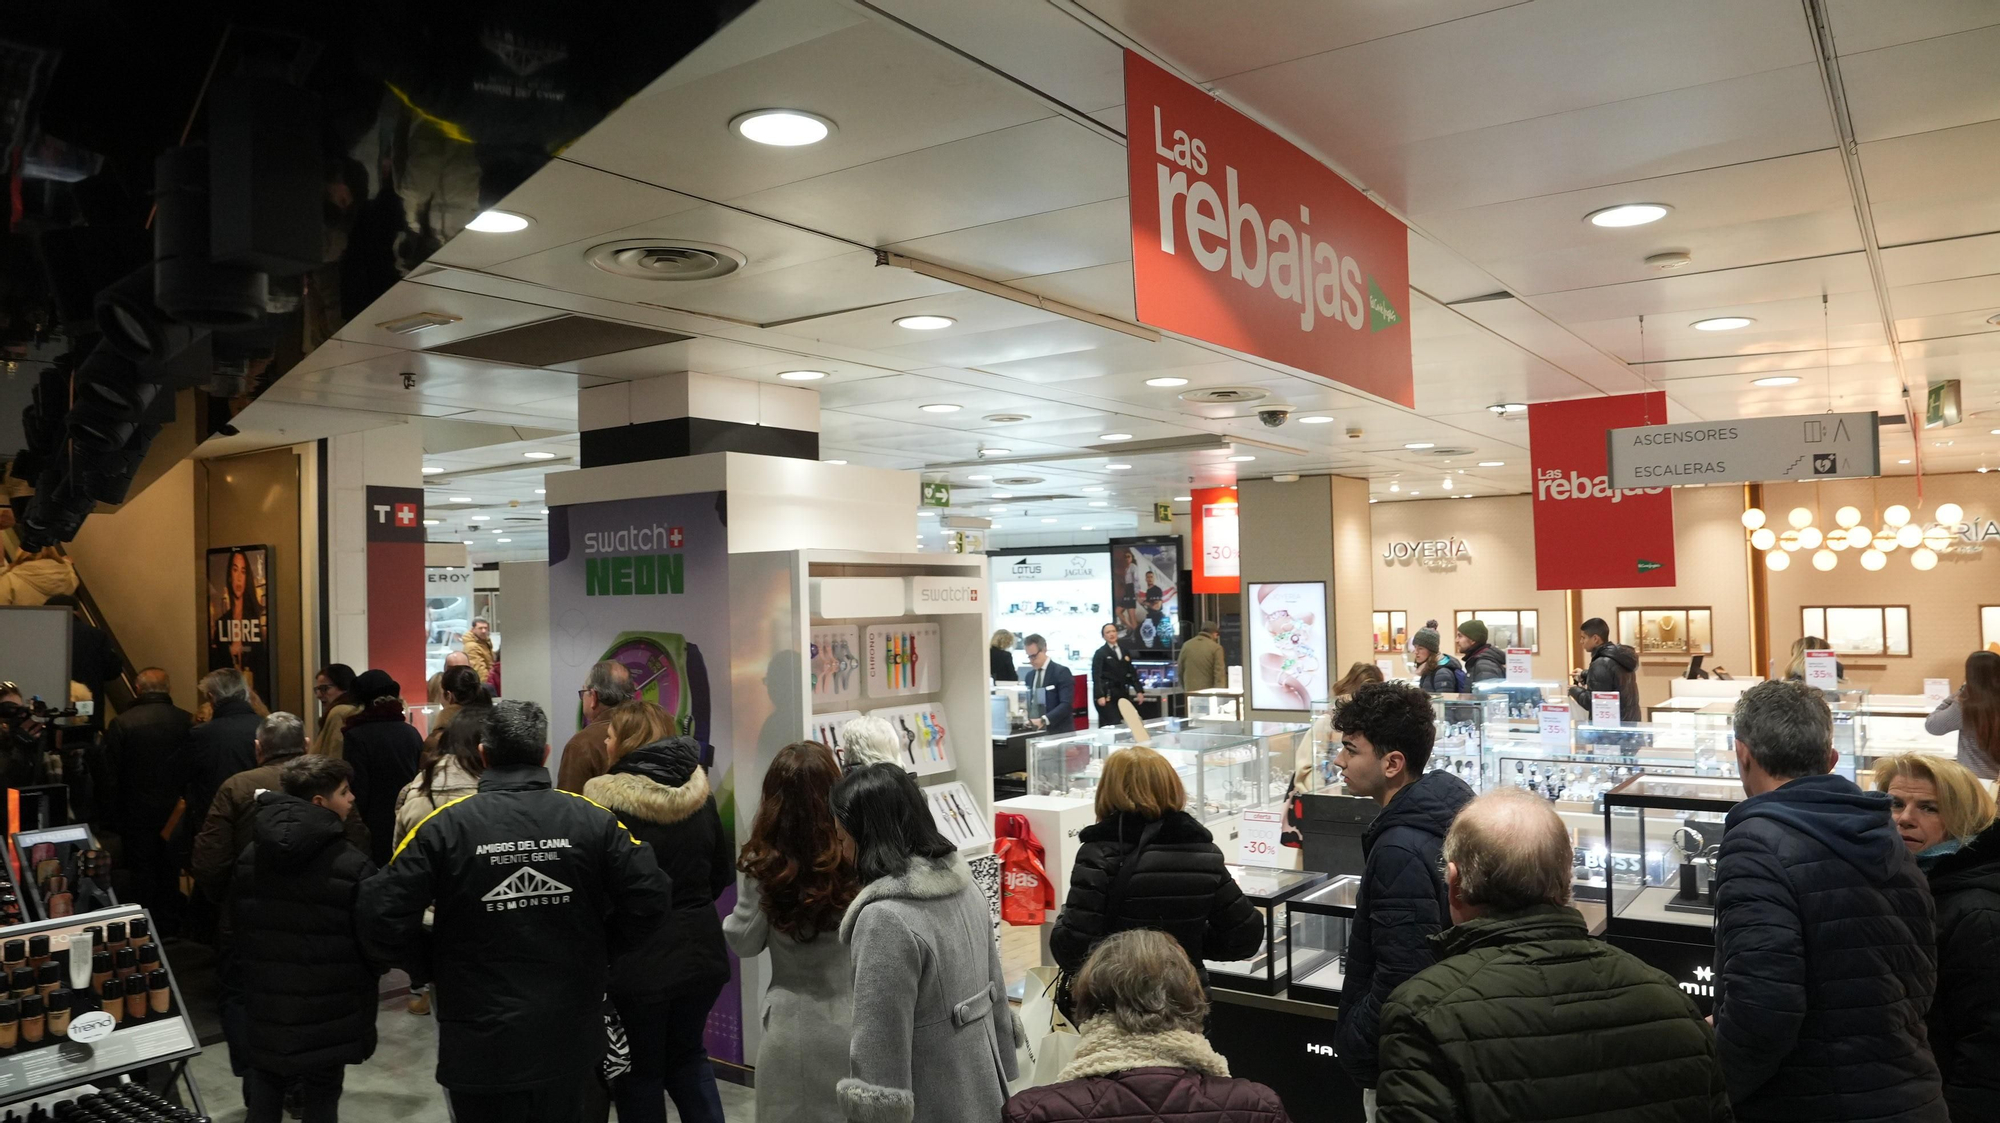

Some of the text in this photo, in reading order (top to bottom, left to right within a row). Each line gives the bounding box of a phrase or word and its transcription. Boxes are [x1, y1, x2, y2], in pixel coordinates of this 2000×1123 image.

[1153, 105, 1208, 176] Las
[1156, 162, 1365, 333] rebajas
[1633, 427, 1739, 446] ASCENSORES
[1537, 467, 1563, 479] Las
[1634, 461, 1726, 478] ESCALERAS
[584, 523, 667, 553] swatch
[1382, 536, 1470, 558] JOYERÍA
[585, 553, 684, 596] NEON
[1012, 565, 1042, 575] LOTUS
[1064, 568, 1094, 578] JAGUAR
[921, 586, 970, 602] swatch
[217, 618, 261, 642] LIBRE
[1509, 665, 1529, 674] -35%
[1809, 669, 1834, 679] -35%
[1595, 710, 1617, 719] -35%
[1543, 725, 1567, 734] -35%
[1247, 828, 1274, 839] TODO
[475, 838, 573, 855] AMIGOS DEL CANAL
[1243, 841, 1276, 855] -30%
[490, 851, 561, 866] PUENTE GENIL
[1004, 868, 1039, 889] ajas
[486, 895, 571, 912] ESMONSUR
[51, 934, 70, 945] FO
[70, 1015, 112, 1034] trend
[1307, 1042, 1338, 1057] HA
